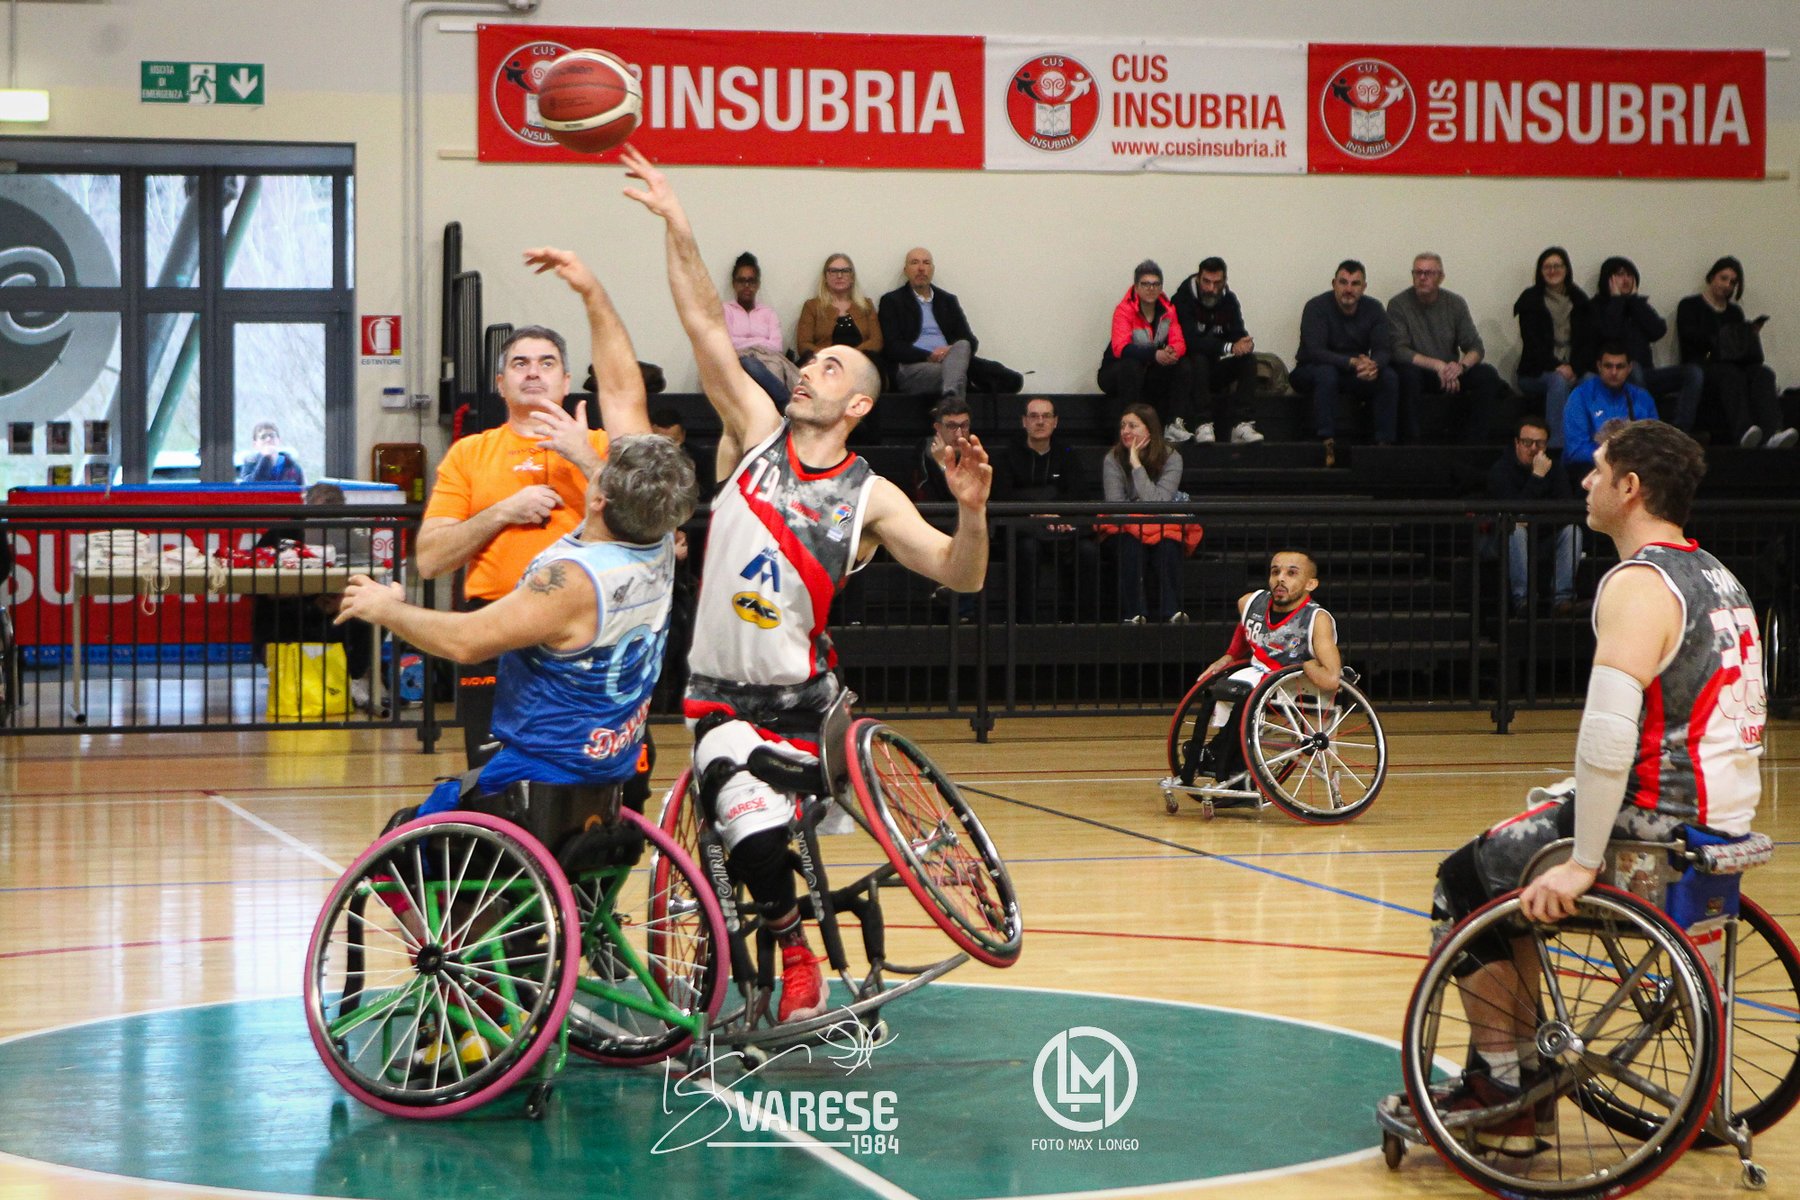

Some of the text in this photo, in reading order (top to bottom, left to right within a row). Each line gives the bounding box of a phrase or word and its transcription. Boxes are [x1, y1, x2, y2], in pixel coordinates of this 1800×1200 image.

[532, 46, 556, 56] CUS
[1042, 57, 1064, 67] CUS
[1112, 53, 1168, 83] CUS
[652, 64, 965, 134] INSUBRIA
[1112, 92, 1286, 130] INSUBRIA
[1428, 78, 1457, 143] CUS
[1465, 79, 1751, 147] INSUBRIA
[1030, 135, 1078, 149] INSUBRIA
[1112, 138, 1287, 158] www.cusinsubria.it
[1245, 618, 1262, 643] 58
[726, 797, 767, 820] VARESE
